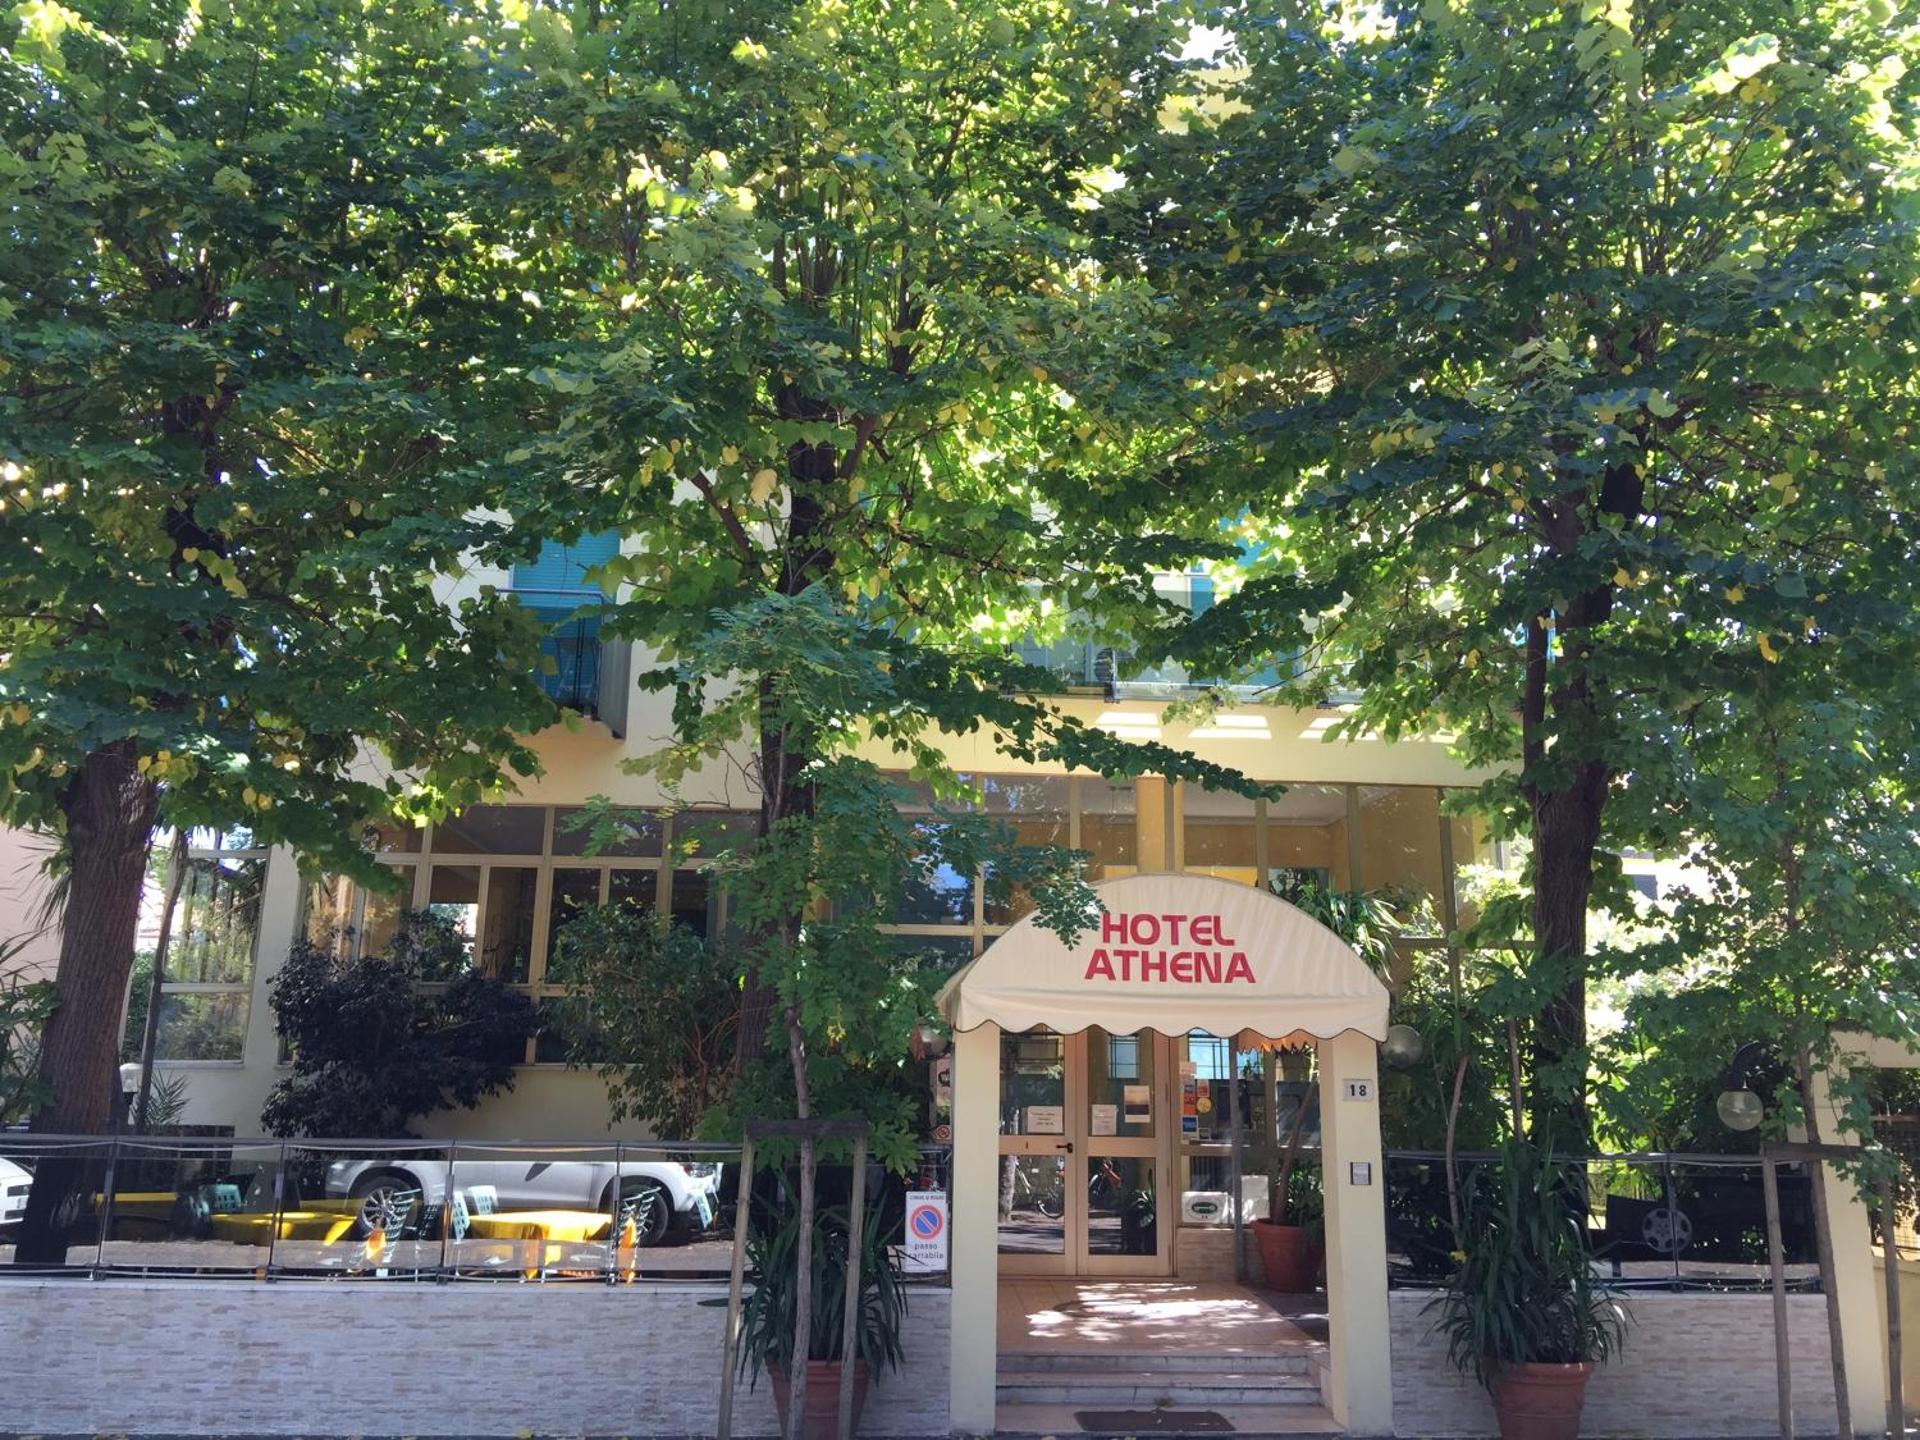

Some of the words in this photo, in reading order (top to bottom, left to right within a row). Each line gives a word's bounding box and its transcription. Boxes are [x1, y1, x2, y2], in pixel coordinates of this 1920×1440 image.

[1102, 913, 1235, 946] HOTEL
[1085, 949, 1256, 984] ATHENA
[1350, 1084, 1367, 1097] 18
[914, 1243, 938, 1251] passo
